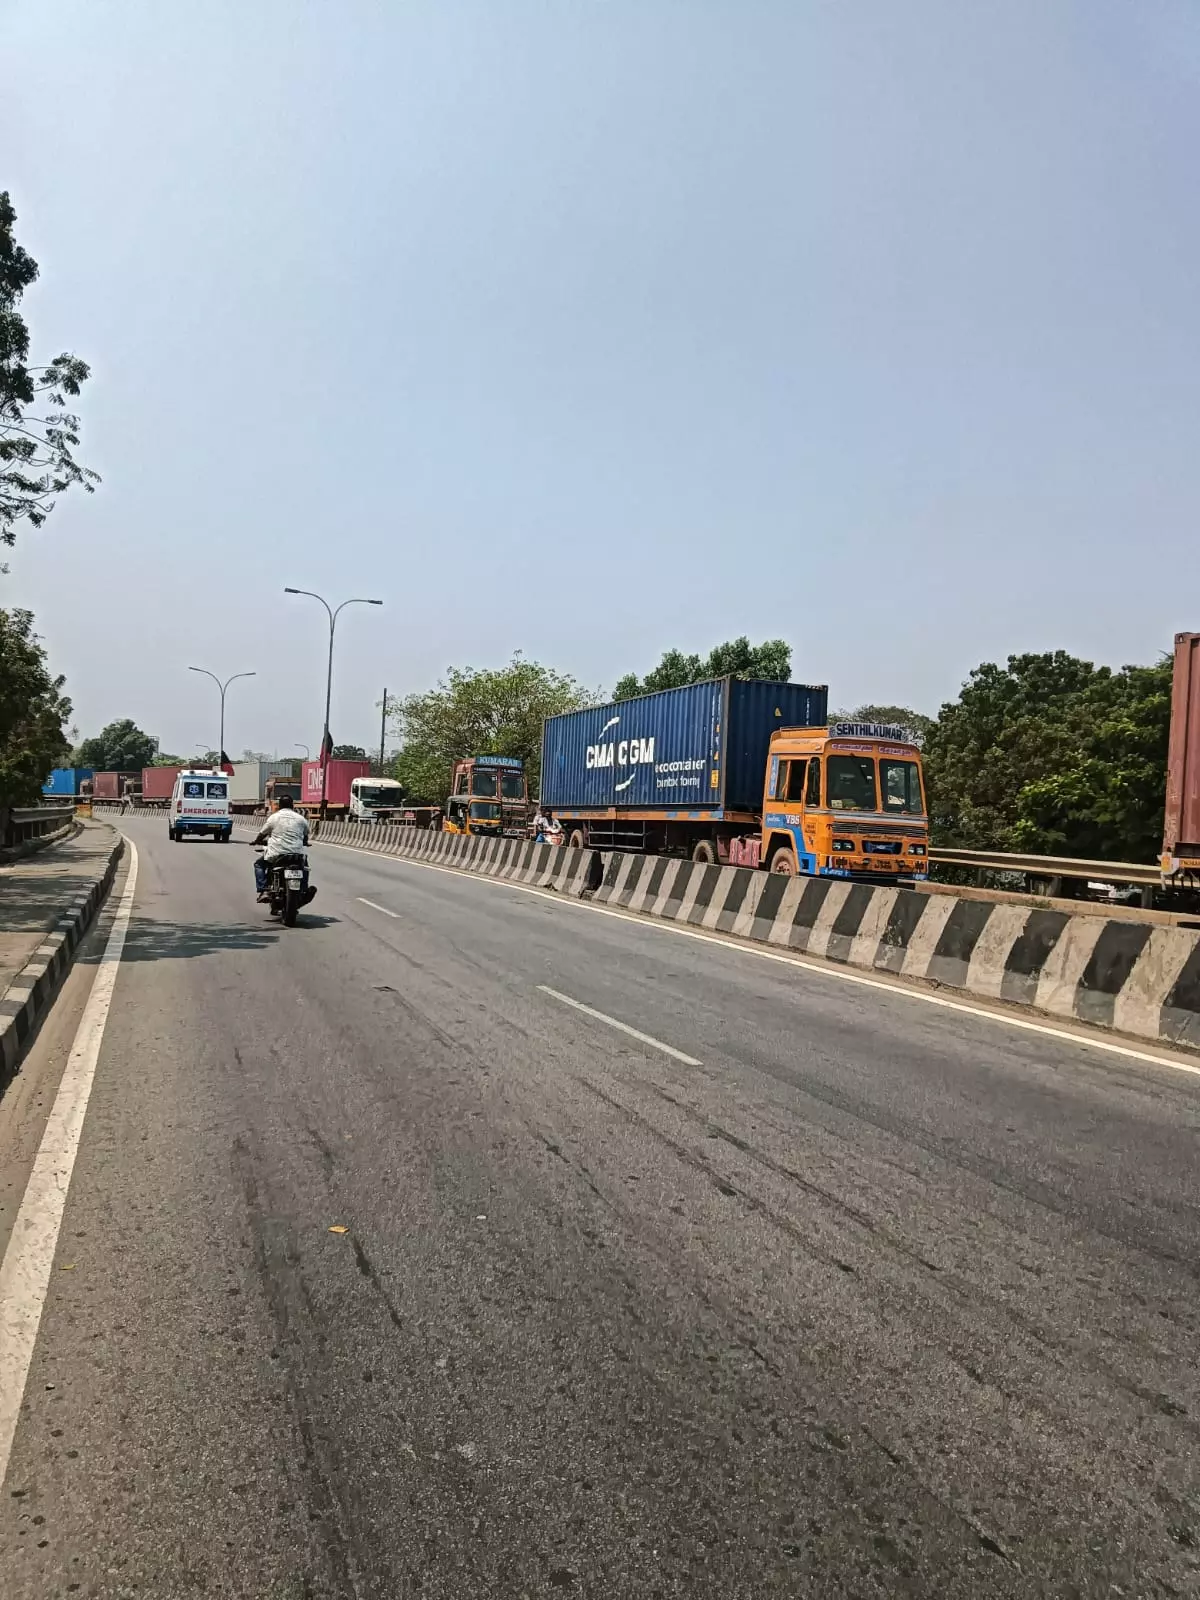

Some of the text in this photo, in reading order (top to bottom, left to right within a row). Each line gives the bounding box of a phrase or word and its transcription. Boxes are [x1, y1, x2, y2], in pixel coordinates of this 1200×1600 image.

[586, 737, 655, 769] CMA CGM
[183, 807, 226, 815] EMERGENCY
